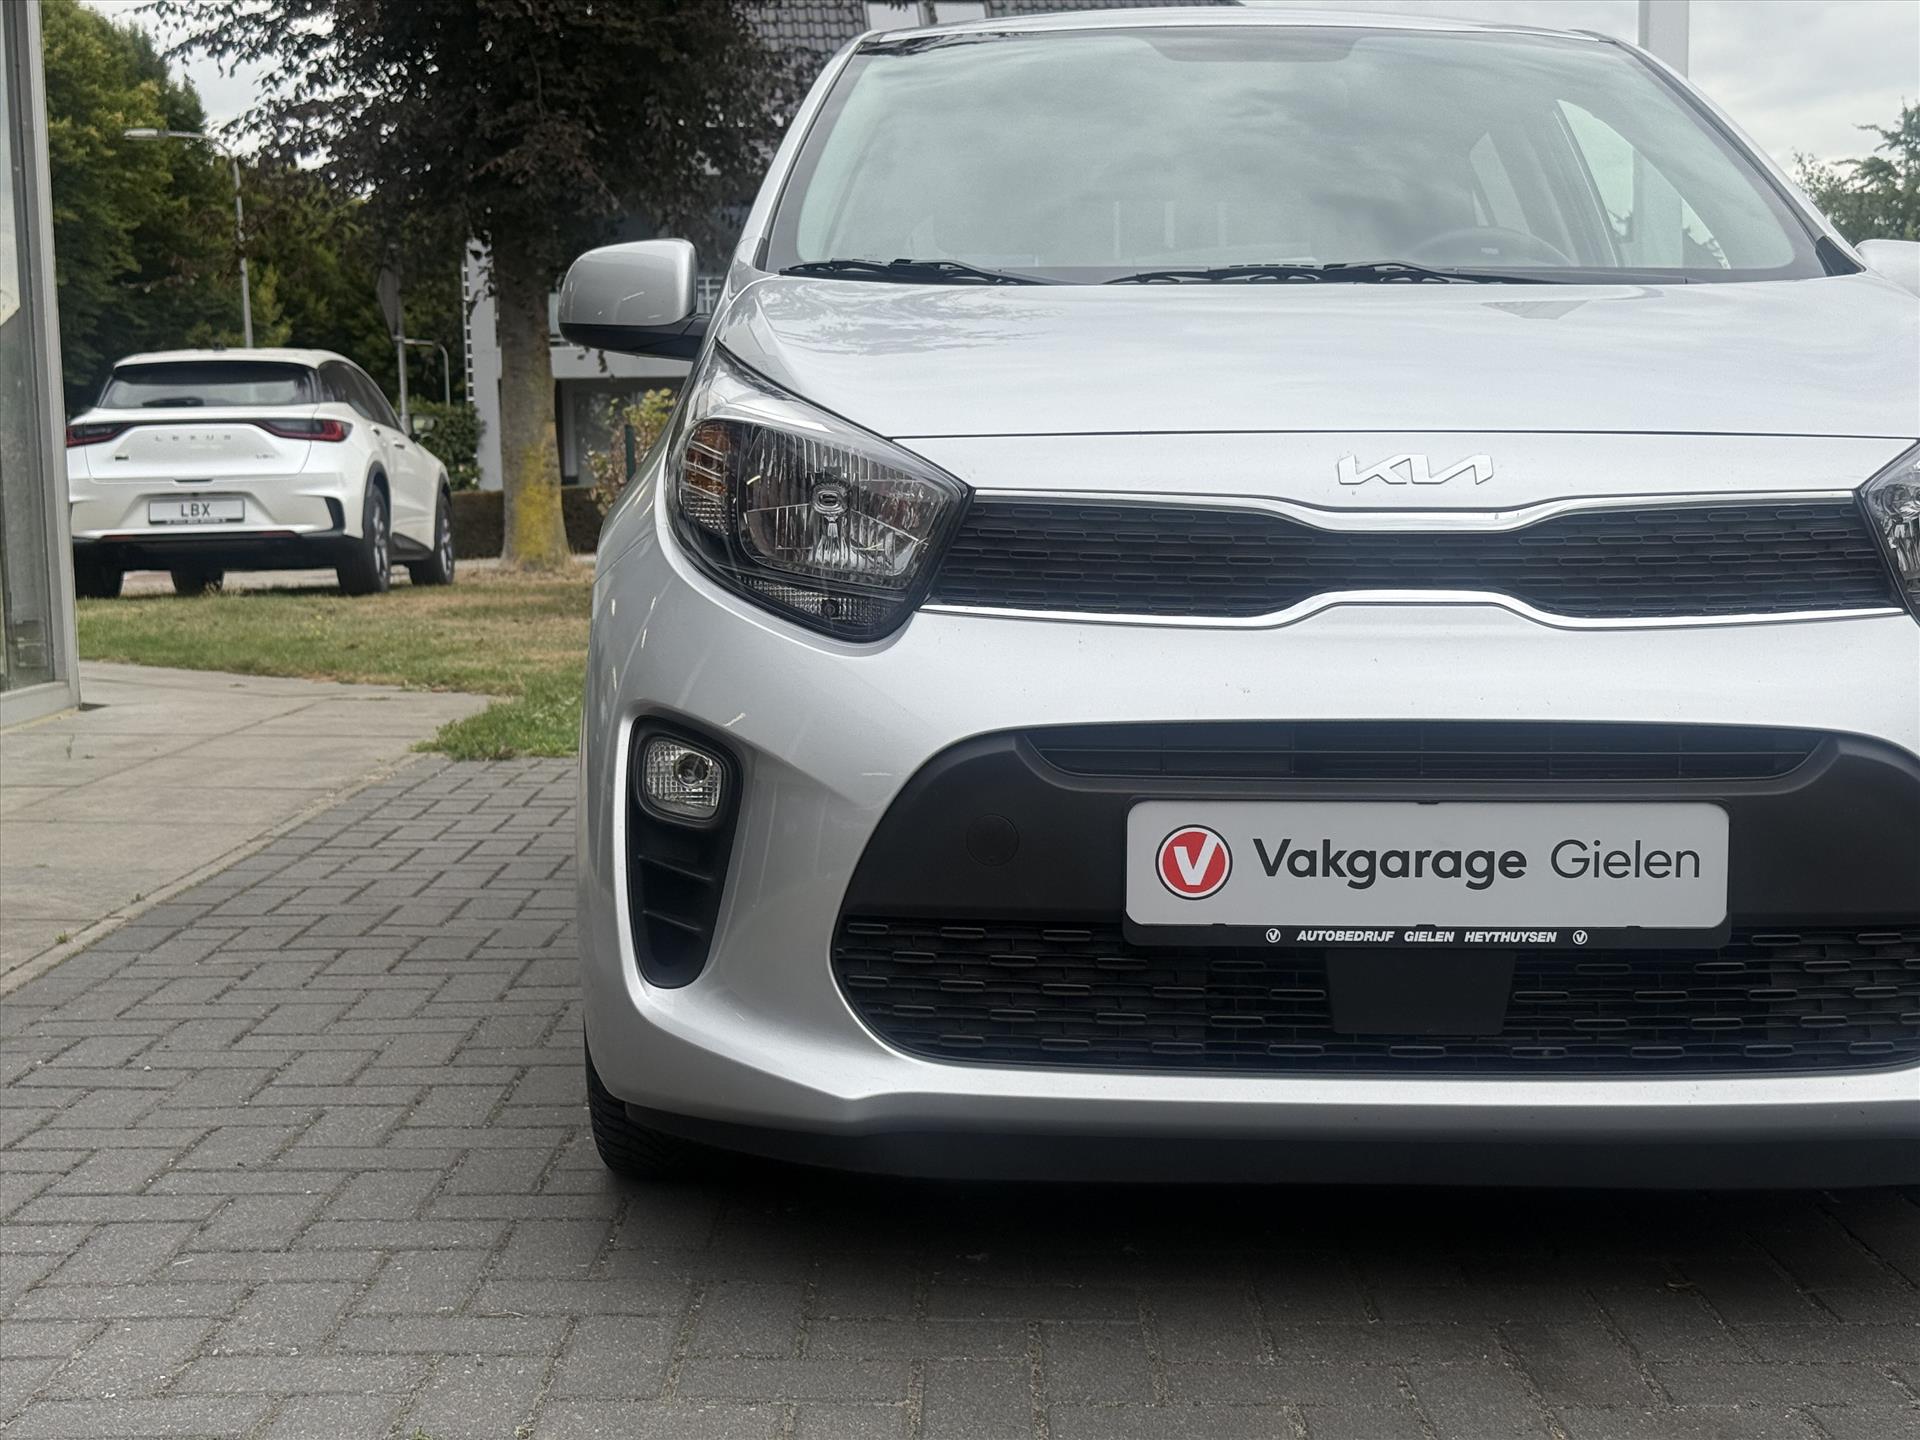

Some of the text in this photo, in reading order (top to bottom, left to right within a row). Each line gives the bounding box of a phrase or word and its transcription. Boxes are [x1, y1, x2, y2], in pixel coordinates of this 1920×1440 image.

[1337, 454, 1494, 485] KIA
[180, 503, 211, 517] LBX
[1169, 829, 1223, 888] V
[1252, 838, 1700, 890] Vakgarage Gielen
[1296, 930, 1395, 942] AUTOBEDRIJF
[1403, 931, 1455, 943] GIELEN
[1464, 931, 1557, 943] HEYTHUYSEN
